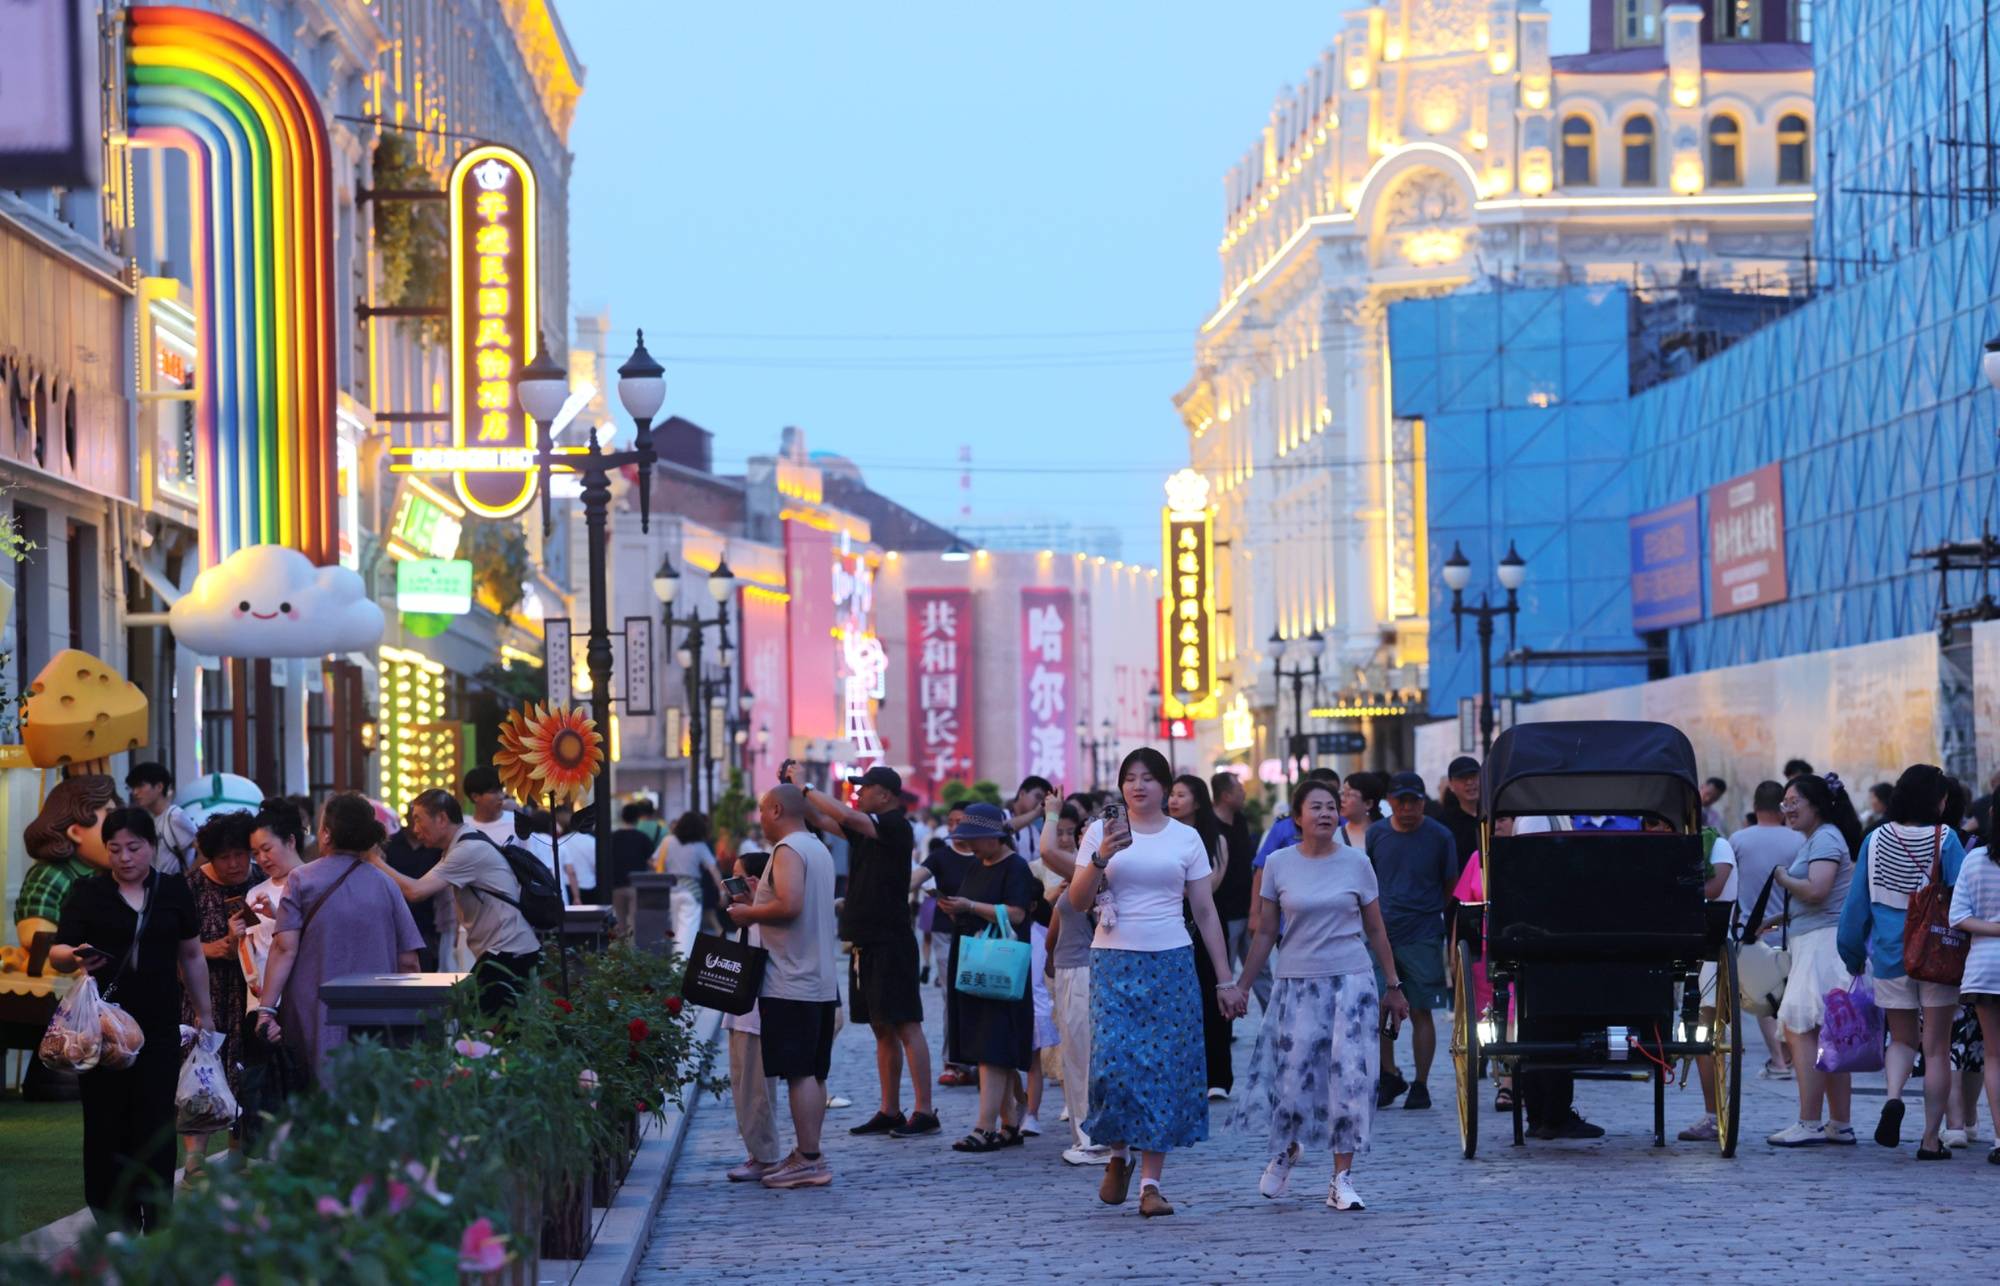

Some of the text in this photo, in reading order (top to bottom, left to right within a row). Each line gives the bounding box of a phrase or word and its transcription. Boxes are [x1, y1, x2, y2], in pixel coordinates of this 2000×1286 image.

[920, 600, 957, 782] 共和国长子
[1028, 604, 1066, 779] 哈尔滨
